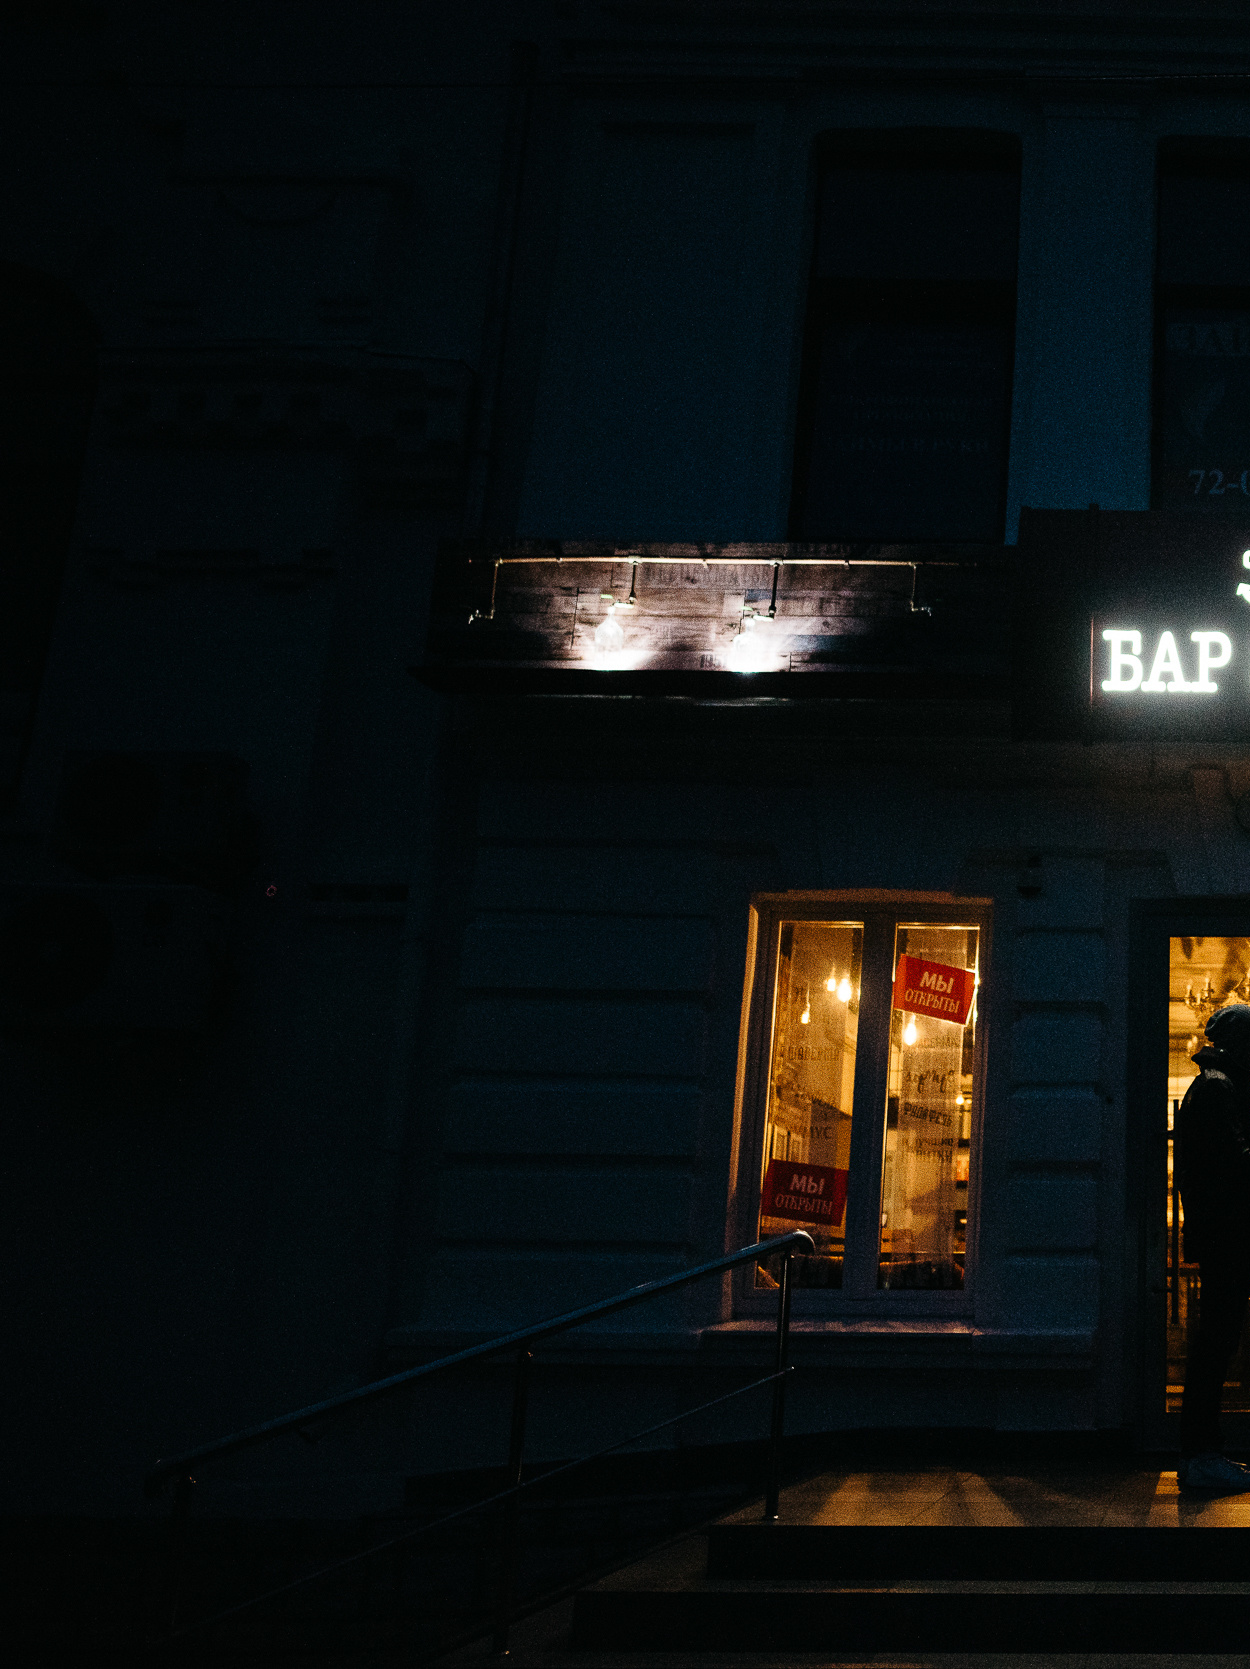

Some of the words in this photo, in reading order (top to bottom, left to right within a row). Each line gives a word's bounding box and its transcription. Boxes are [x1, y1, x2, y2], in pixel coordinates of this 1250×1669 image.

[1101, 629, 1233, 693] БАР
[919, 971, 954, 994] МЫ
[904, 988, 960, 1014] ОТКРЫТЫ
[790, 1173, 825, 1195] МЫ
[775, 1194, 834, 1216] ОТКРЫТЫ
